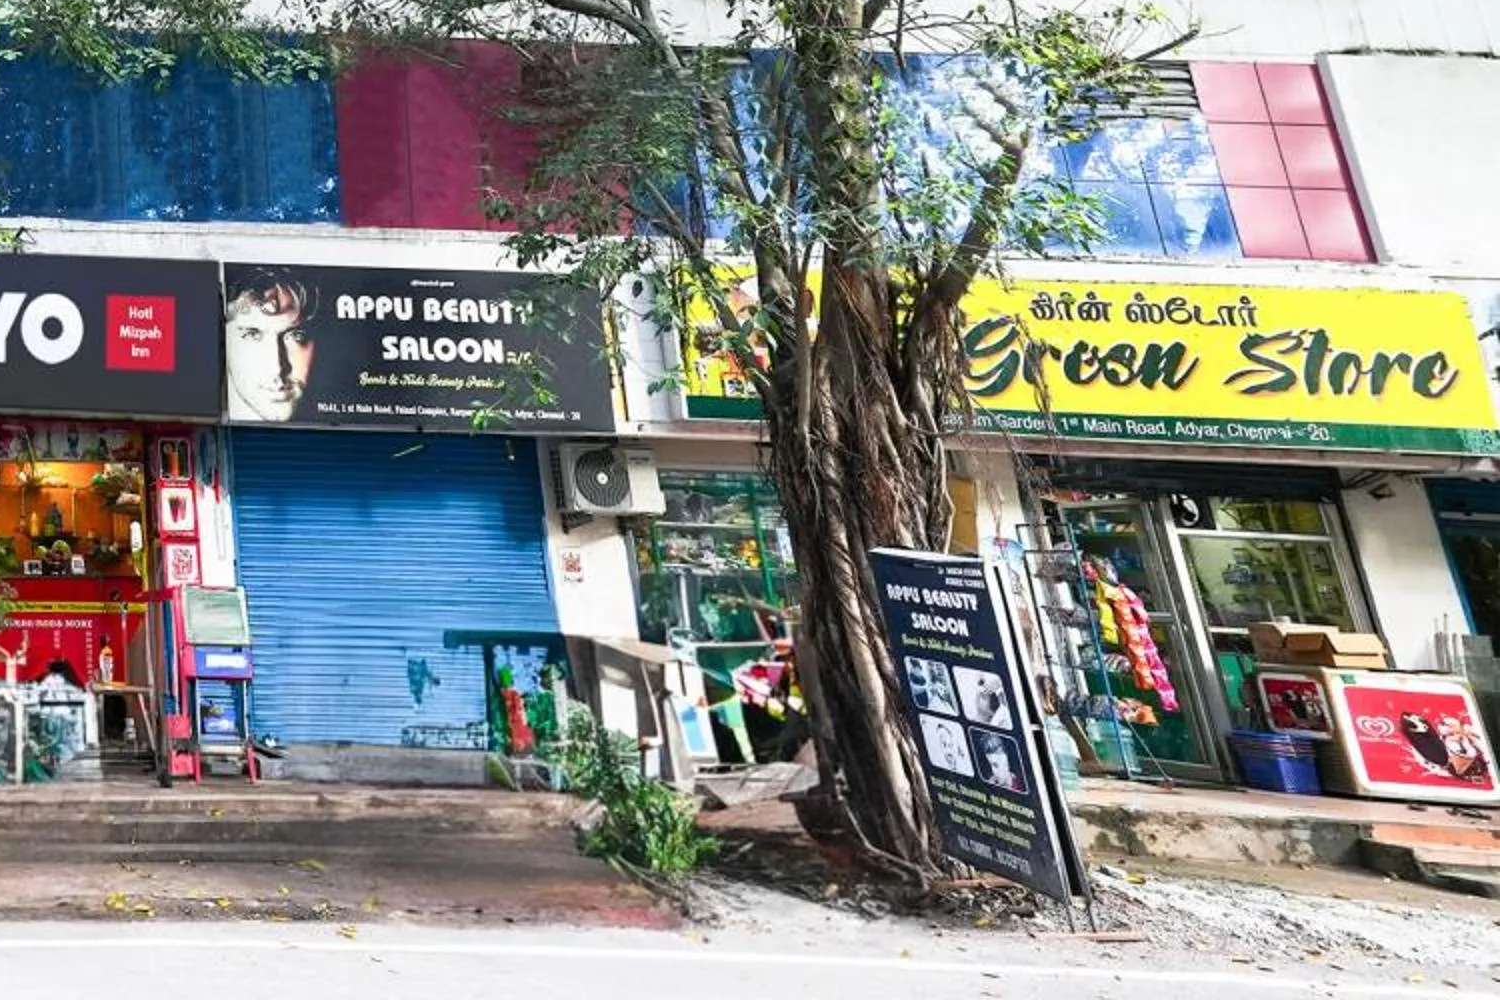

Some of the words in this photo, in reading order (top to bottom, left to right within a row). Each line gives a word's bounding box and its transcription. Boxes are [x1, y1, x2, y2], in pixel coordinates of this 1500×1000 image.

[337, 294, 413, 322] APPU
[1125, 292, 1257, 327] ஸ்டோர்
[119, 324, 162, 341] Mizpah
[131, 344, 150, 357] Inn
[381, 335, 505, 364] SALOON
[961, 315, 1199, 397] Green
[1222, 328, 1459, 400] Store
[1084, 418, 1123, 433] Main
[1125, 420, 1170, 438] Road,
[1174, 420, 1224, 440] Adyar,
[922, 588, 977, 611] BEAUTY
[911, 612, 969, 637] SALOON
